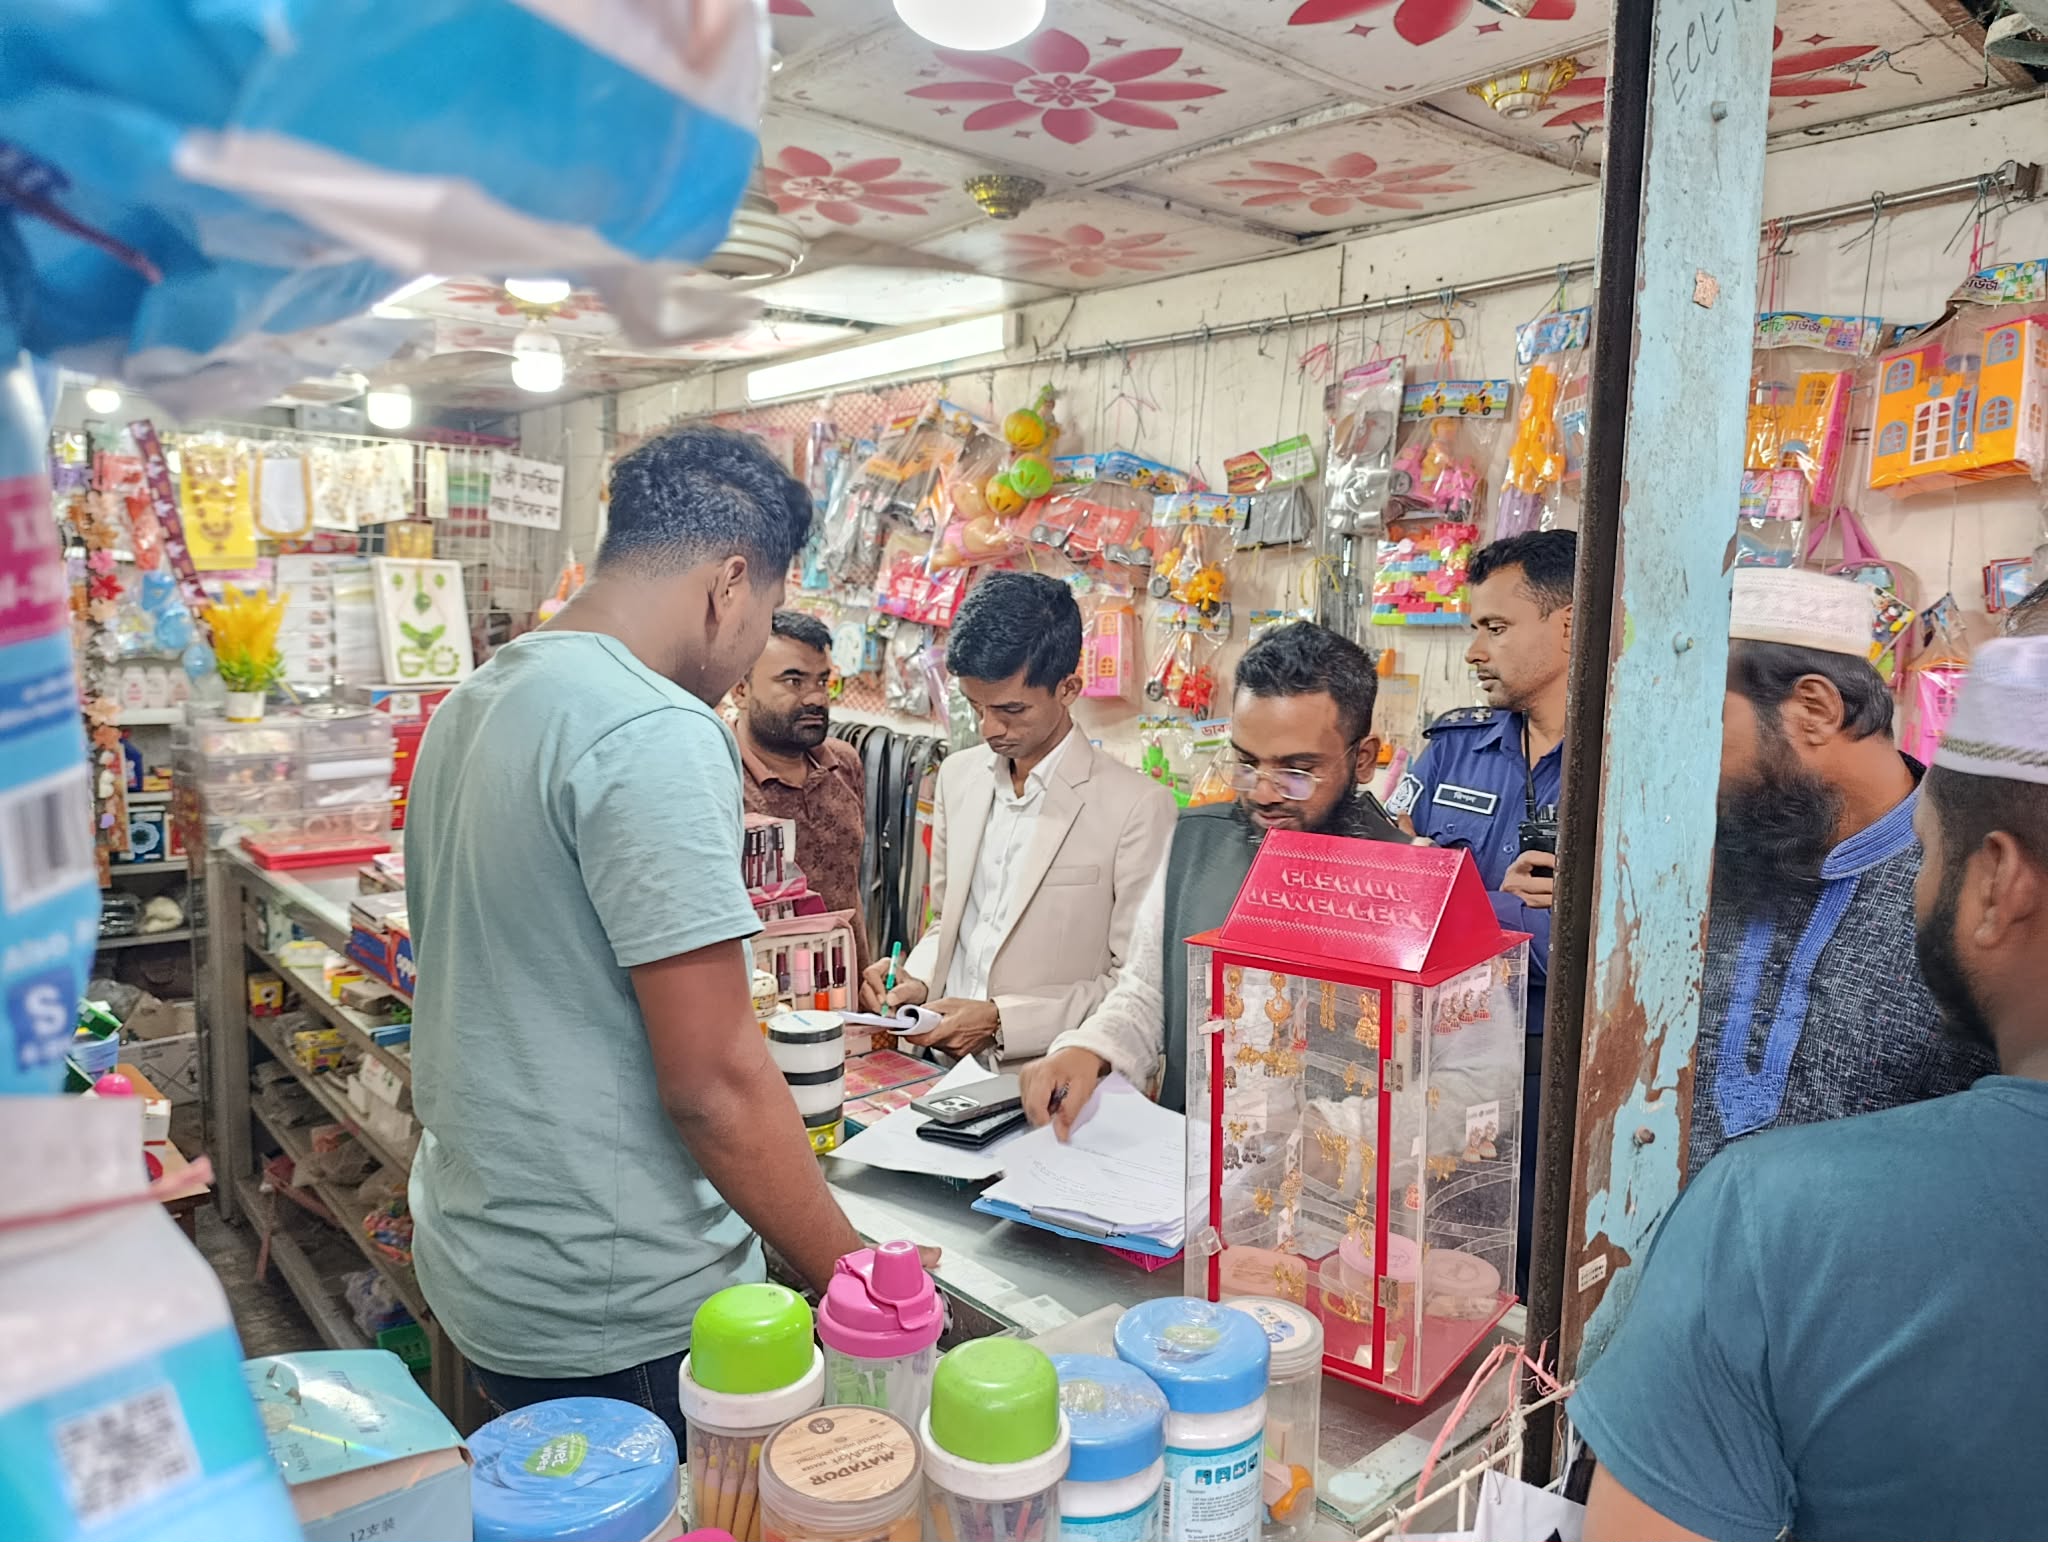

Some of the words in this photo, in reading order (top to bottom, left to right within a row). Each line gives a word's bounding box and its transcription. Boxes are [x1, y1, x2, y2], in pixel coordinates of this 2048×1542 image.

[1281, 867, 1413, 903] FASHION
[1246, 888, 1431, 931] JEWELLERY
[809, 1450, 895, 1486] MATADOR
